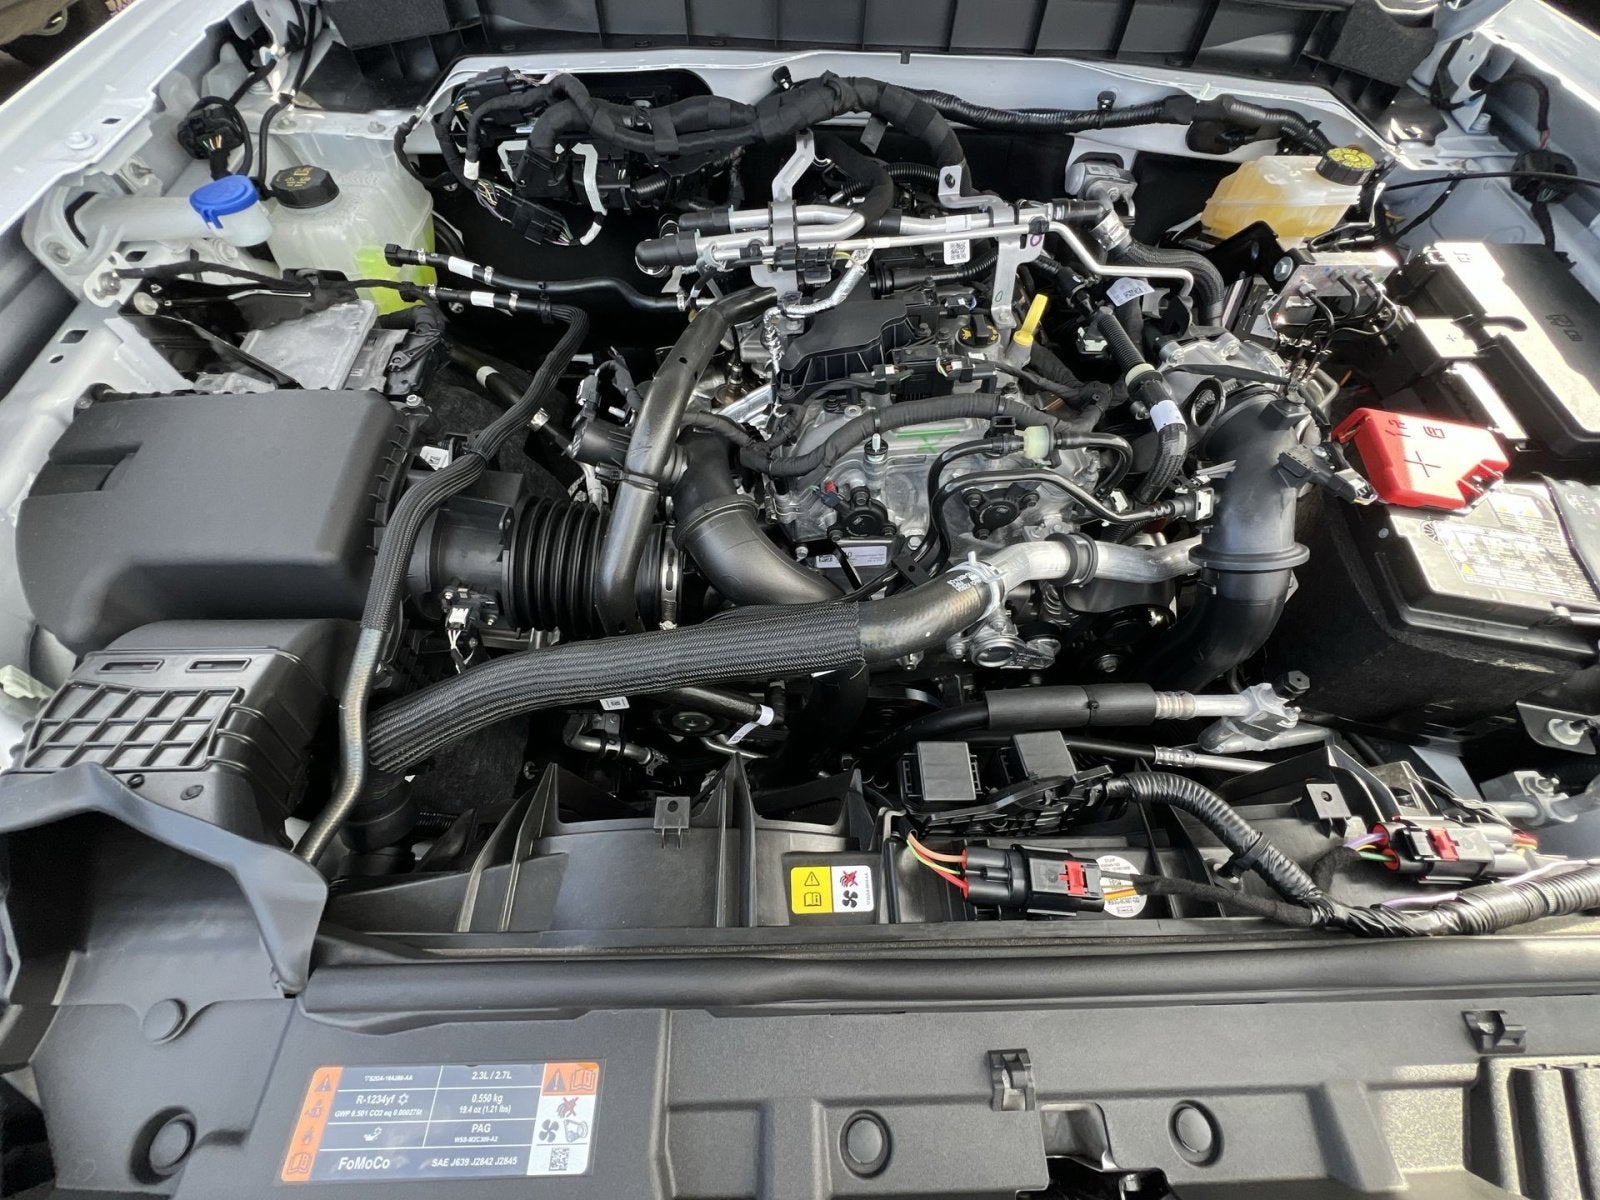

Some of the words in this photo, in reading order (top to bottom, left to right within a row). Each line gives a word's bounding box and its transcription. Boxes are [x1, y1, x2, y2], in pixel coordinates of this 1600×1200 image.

[471, 1071, 488, 1080] 2.3L
[495, 1070, 512, 1080] 2.7L
[355, 1094, 396, 1106] R-1234yf
[471, 1093, 492, 1103] 0.550
[492, 1093, 503, 1105] kg
[459, 1105, 473, 1114] 19.4
[473, 1106, 481, 1114] oz
[482, 1105, 498, 1115] (1.21
[499, 1104, 512, 1114] lbs)
[471, 1123, 492, 1133] PAG
[337, 1155, 391, 1170] FoMoCo
[431, 1157, 450, 1167] SAE
[450, 1157, 470, 1167] J639
[470, 1156, 494, 1166] J2842
[494, 1156, 518, 1166] J2845
